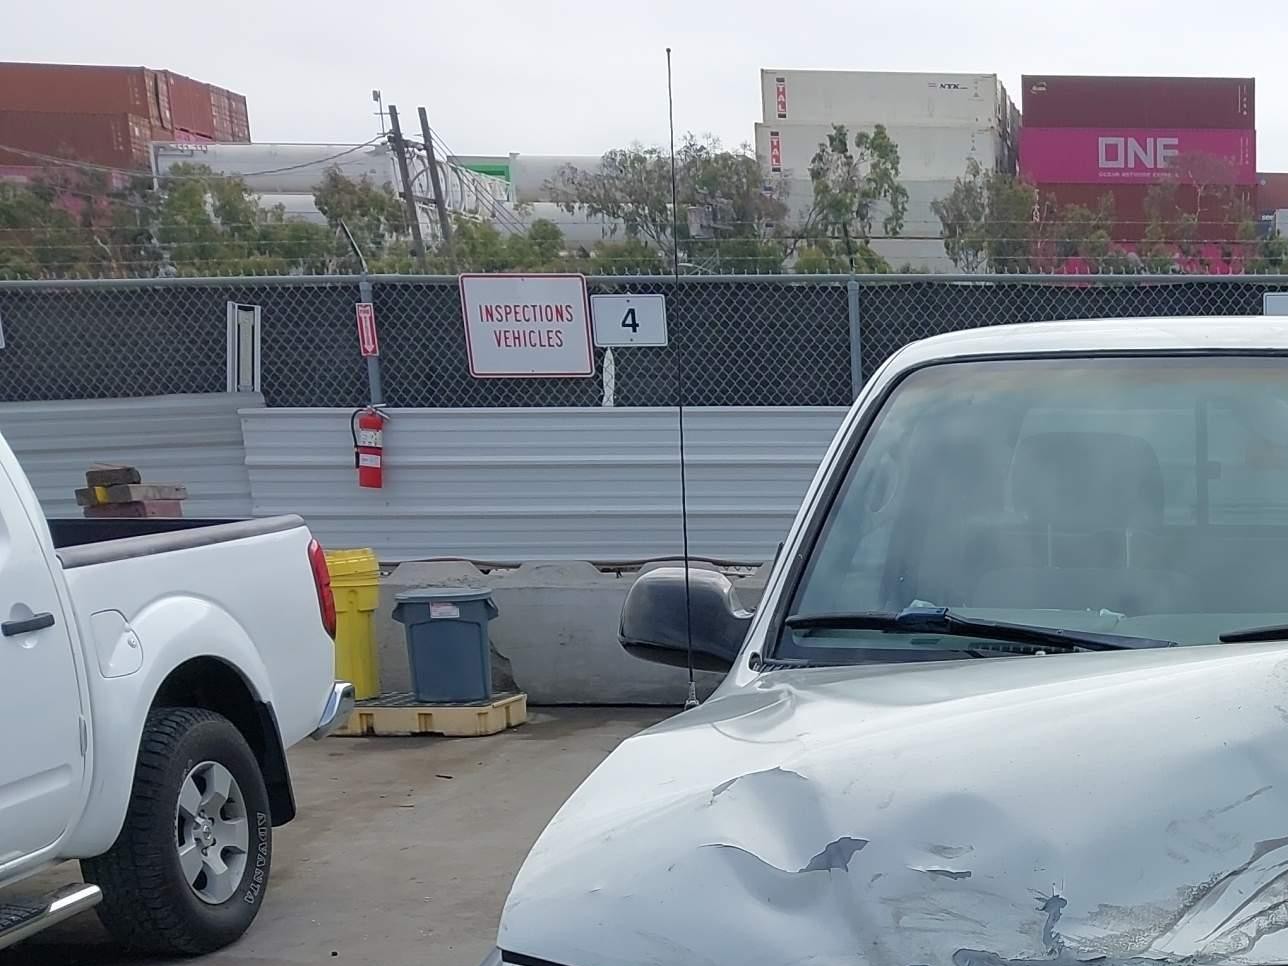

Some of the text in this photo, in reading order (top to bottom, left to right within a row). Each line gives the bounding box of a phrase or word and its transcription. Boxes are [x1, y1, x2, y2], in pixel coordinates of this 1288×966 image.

[777, 85, 786, 112] TAL
[771, 138, 780, 165] TAL
[1098, 137, 1179, 168] ONE
[479, 304, 574, 323] INSPECTIONS
[621, 308, 640, 333] 4
[493, 330, 564, 348] VEHICLES
